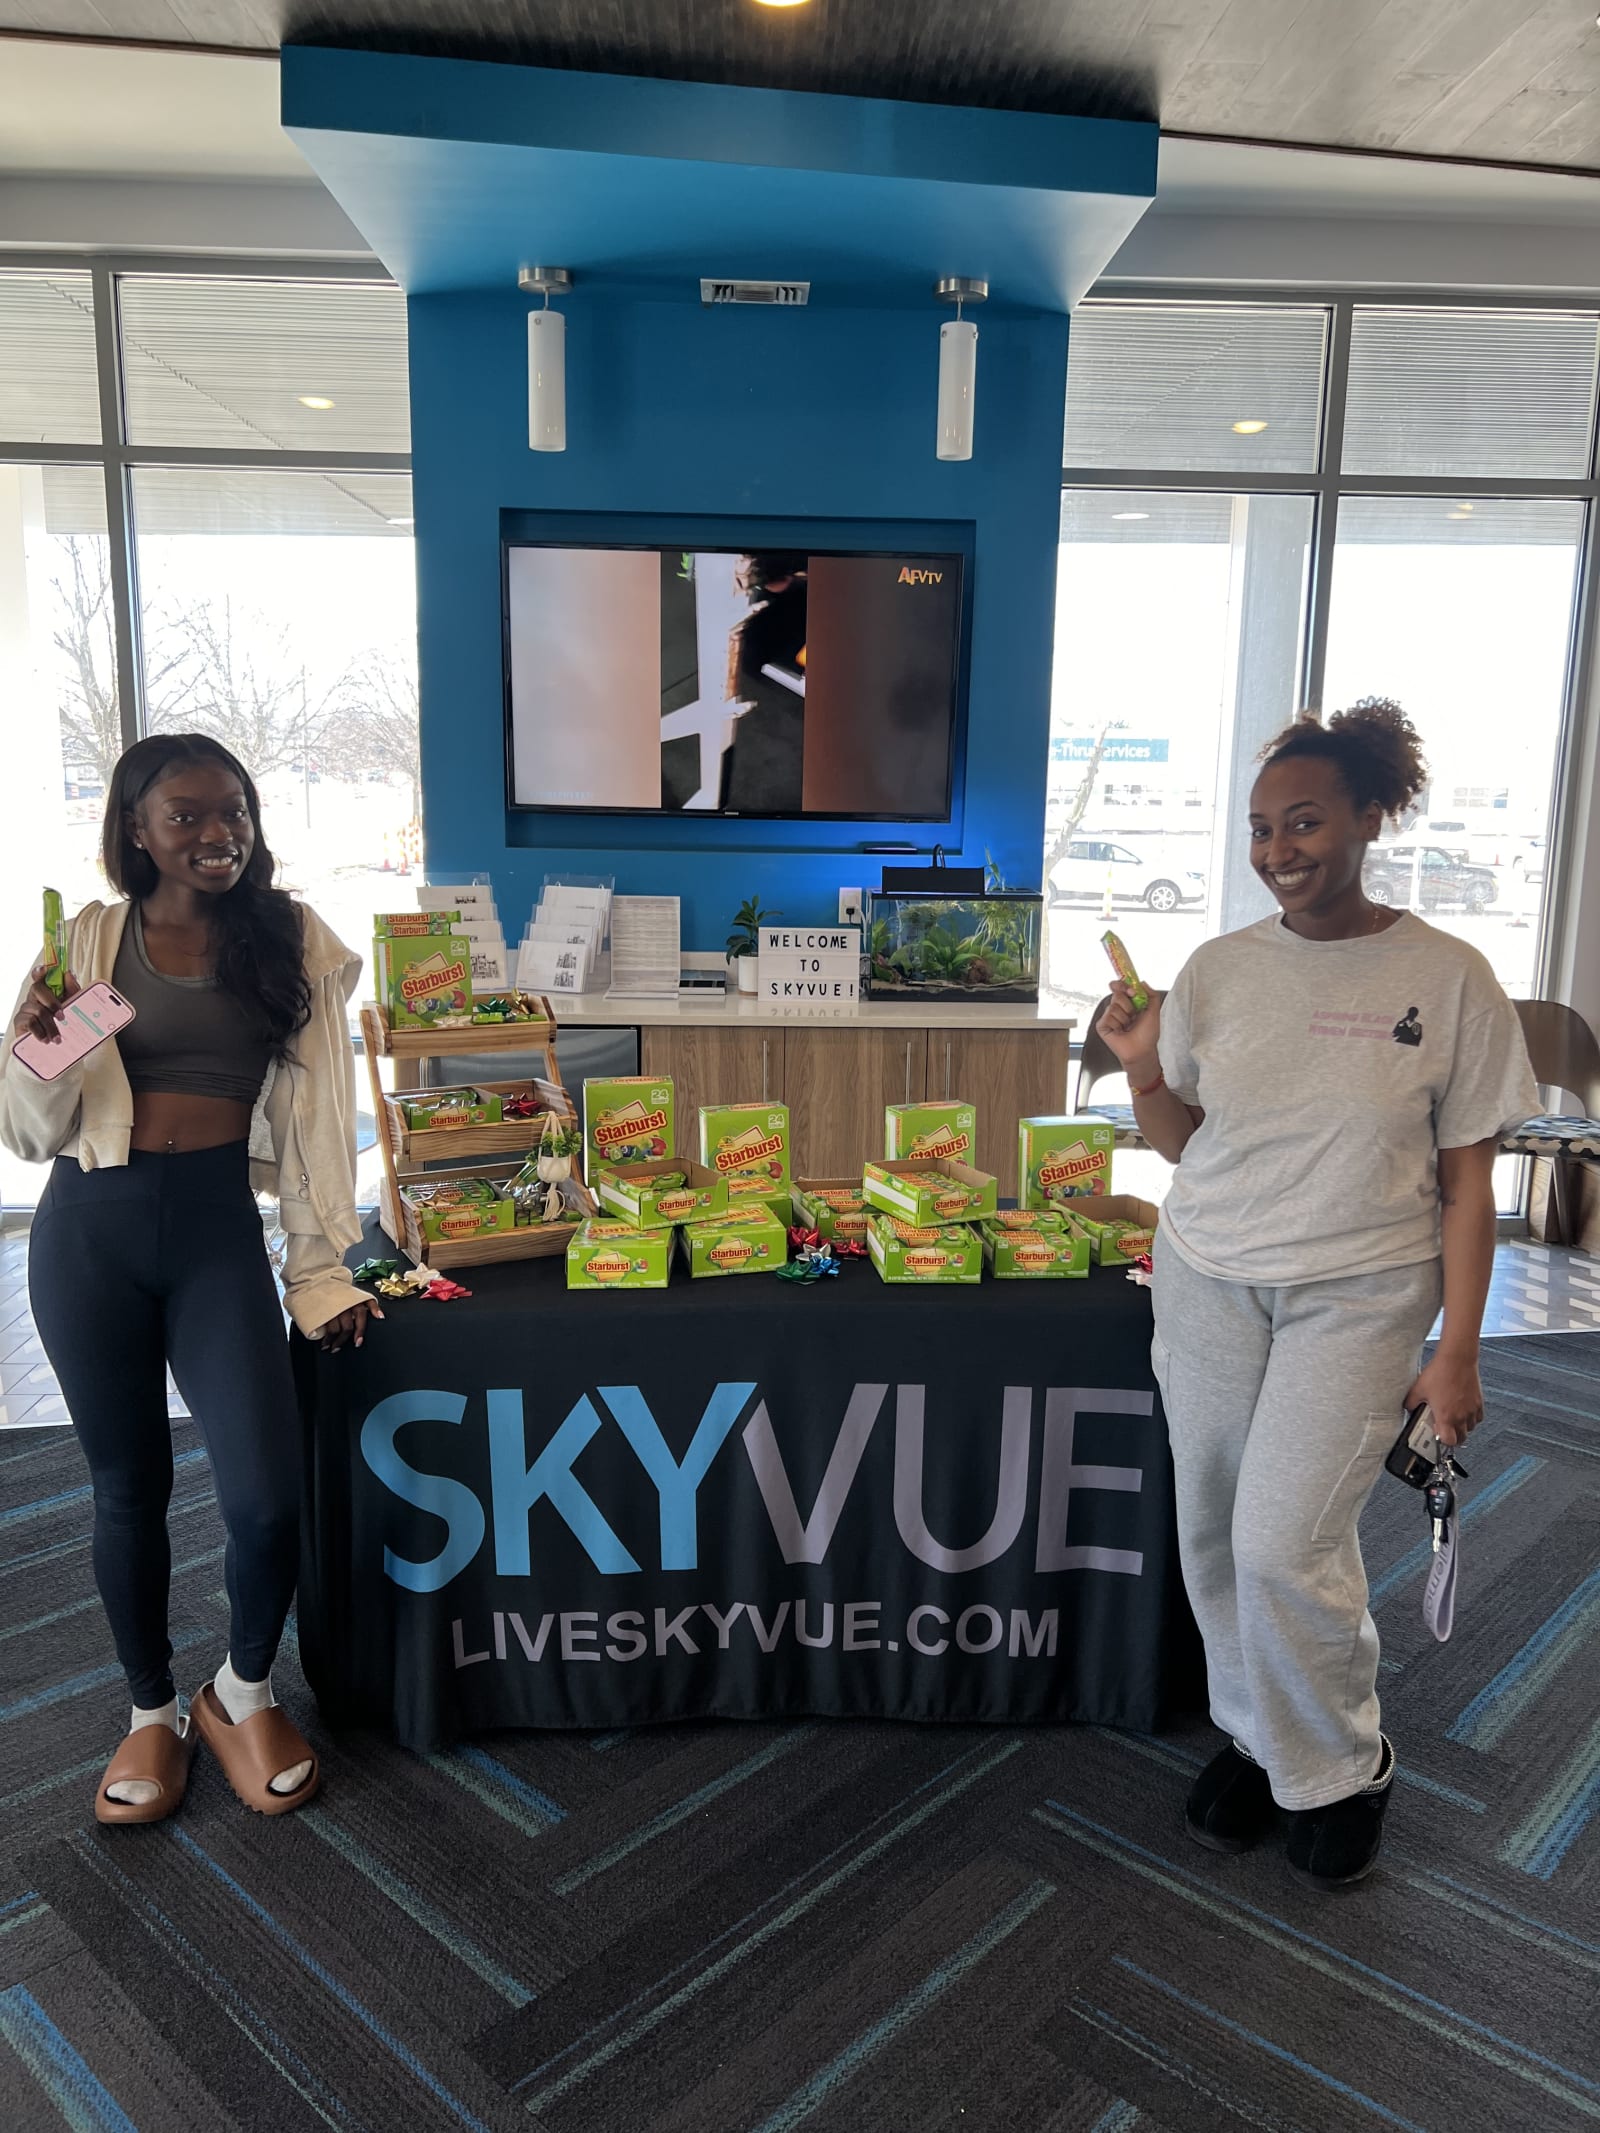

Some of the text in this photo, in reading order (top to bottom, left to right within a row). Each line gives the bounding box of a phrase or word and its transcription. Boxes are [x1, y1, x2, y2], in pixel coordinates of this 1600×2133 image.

[1098, 743, 1151, 759] ervices
[388, 913, 430, 923] Starburst
[393, 925, 428, 934] Starburst
[451, 942, 465, 950] 24
[769, 934, 848, 949] WELCOME
[800, 959, 820, 972] TO
[402, 962, 465, 997] Starburst
[652, 1090, 668, 1099] 24
[430, 1114, 469, 1125] Starburst
[769, 1115, 784, 1124] 24
[957, 1114, 970, 1122] 24
[596, 1110, 666, 1142] Starburst
[1094, 1130, 1108, 1139] 24
[717, 1135, 782, 1169] Starburst
[1040, 1151, 1106, 1183] Starburst
[658, 1197, 696, 1210] Starburst
[935, 1197, 968, 1210] Starburst
[441, 1218, 481, 1230] Starburst
[835, 1221, 867, 1229] Starburs
[711, 1247, 752, 1259] Starburst
[1015, 1252, 1055, 1261] Starburst
[587, 1262, 629, 1271] Starburst
[905, 1256, 947, 1265] Starburst
[360, 1382, 1154, 1593] SKYVUE
[452, 1599, 1059, 1669] LIVESKYVUE.COM
